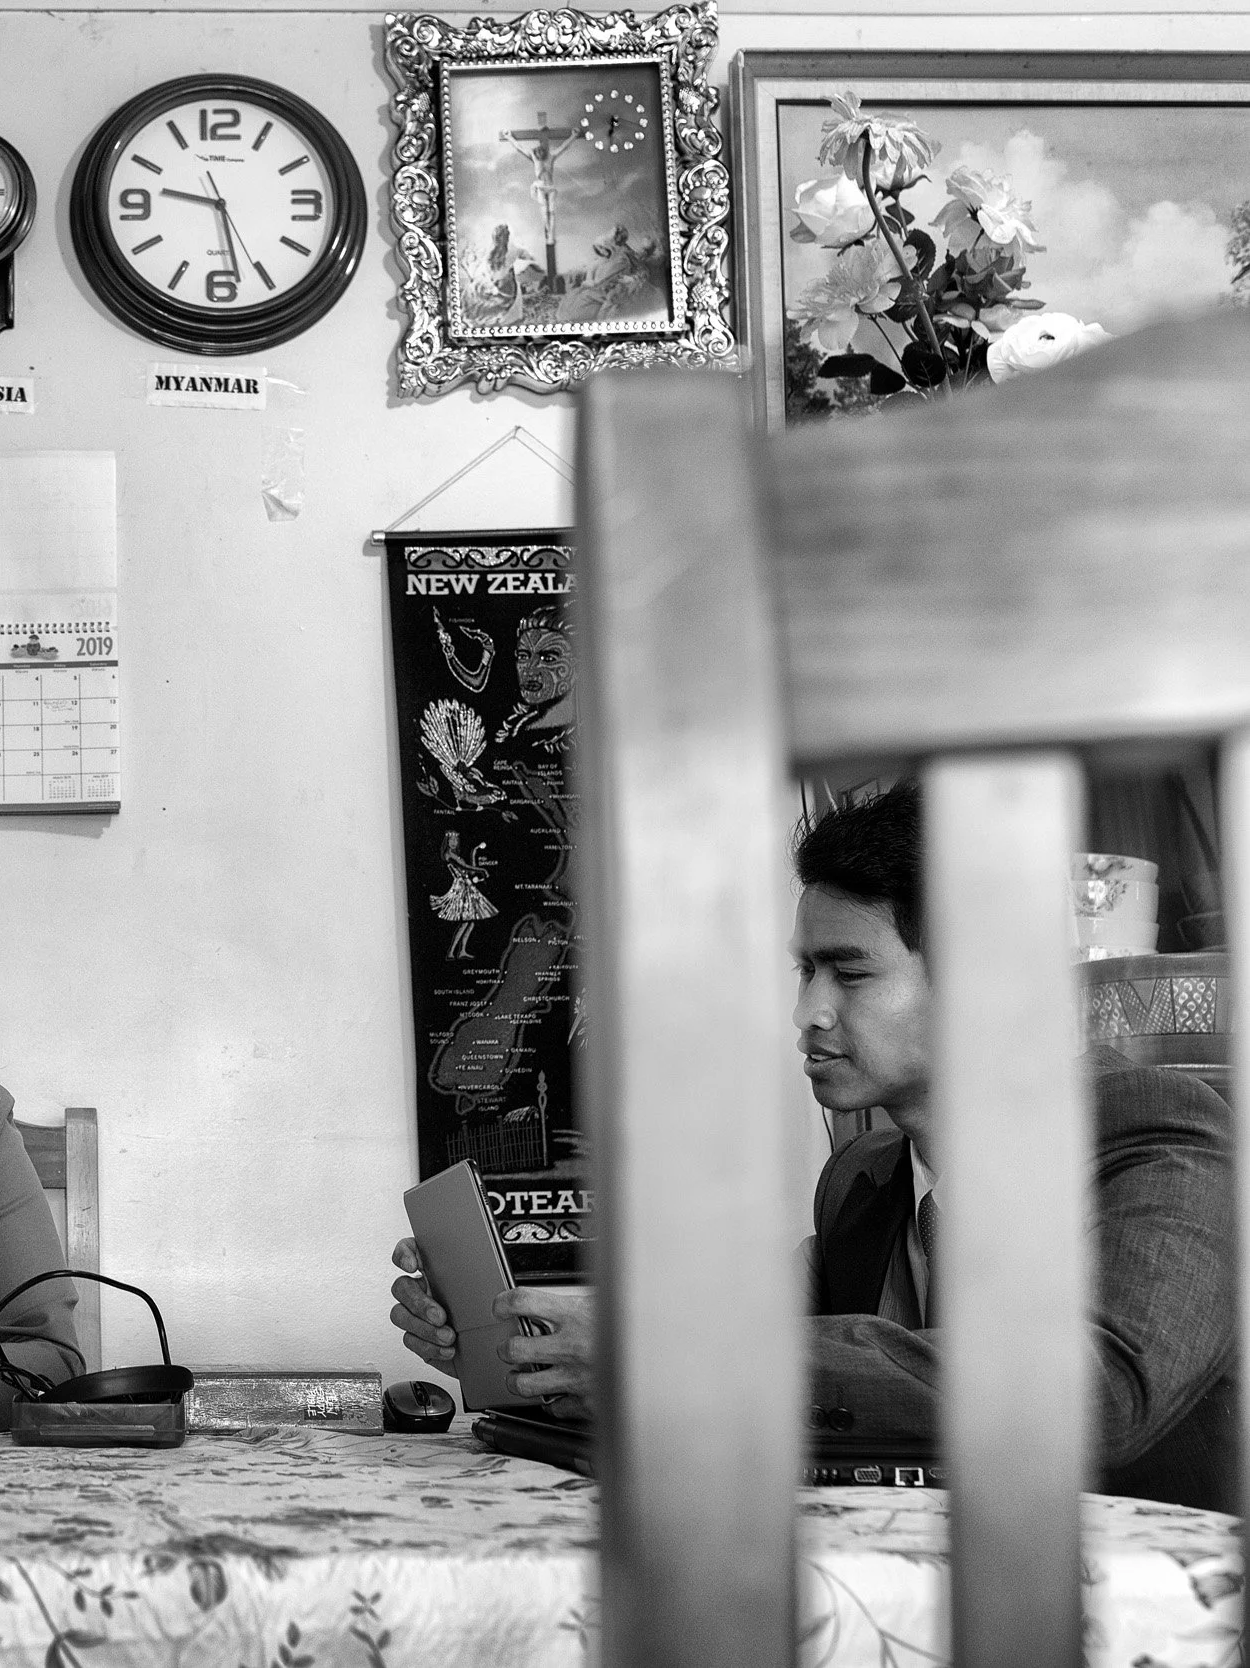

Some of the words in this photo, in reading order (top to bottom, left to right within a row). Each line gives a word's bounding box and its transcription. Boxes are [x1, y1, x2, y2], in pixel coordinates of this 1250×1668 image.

[200, 109, 240, 140] 12
[119, 189, 151, 220] 9
[291, 190, 322, 221] 3
[206, 270, 238, 303] 6
[156, 376, 259, 394] MYANMAR
[406, 574, 479, 595] NEW
[487, 573, 579, 594] ZEALA
[76, 637, 112, 656] 2019
[487, 1190, 594, 1216] OTEAR
